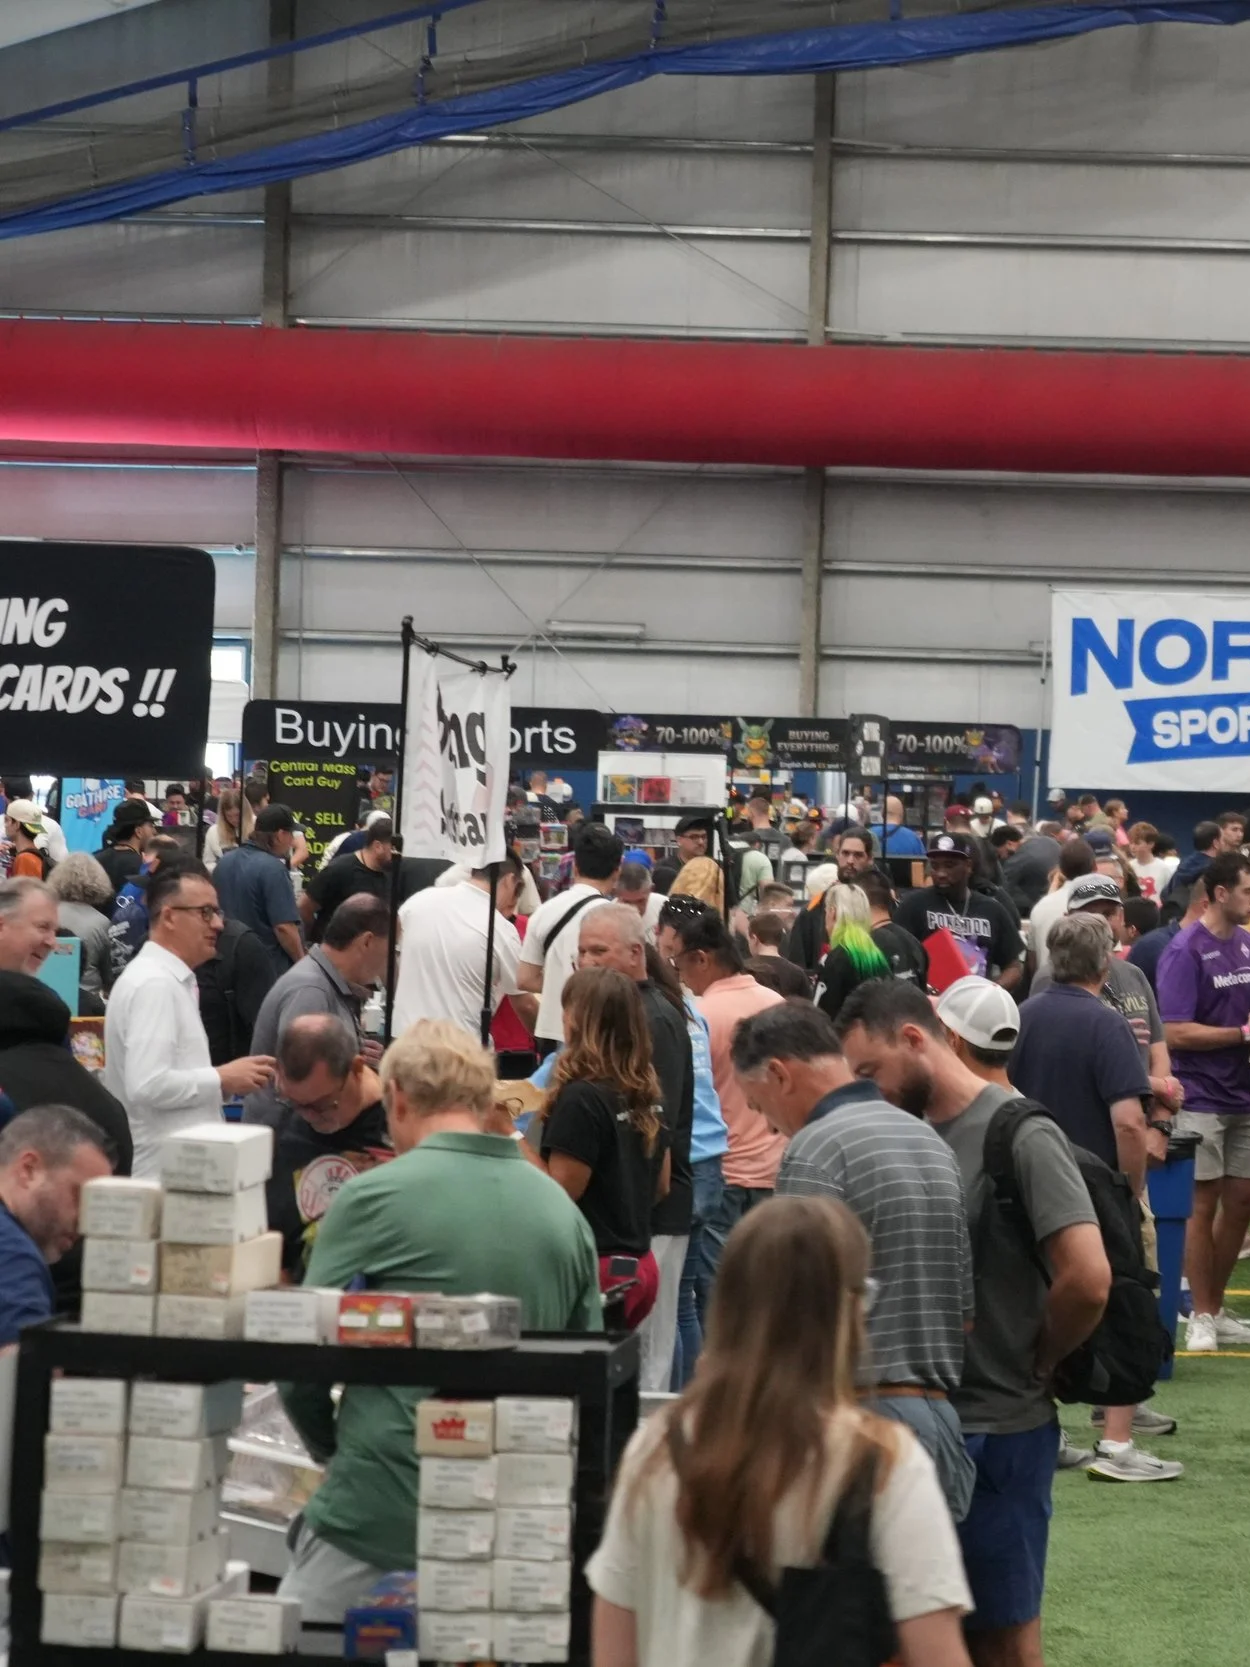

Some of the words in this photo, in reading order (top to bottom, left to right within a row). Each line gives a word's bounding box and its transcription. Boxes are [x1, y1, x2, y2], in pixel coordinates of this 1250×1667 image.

[132, 668, 177, 718] !!
[275, 707, 399, 757] Buyin
[788, 730, 830, 741] BUYING
[777, 742, 840, 753] EVERYTHING
[283, 776, 314, 786] Card
[317, 776, 342, 790] Guy
[315, 812, 345, 826] SELL
